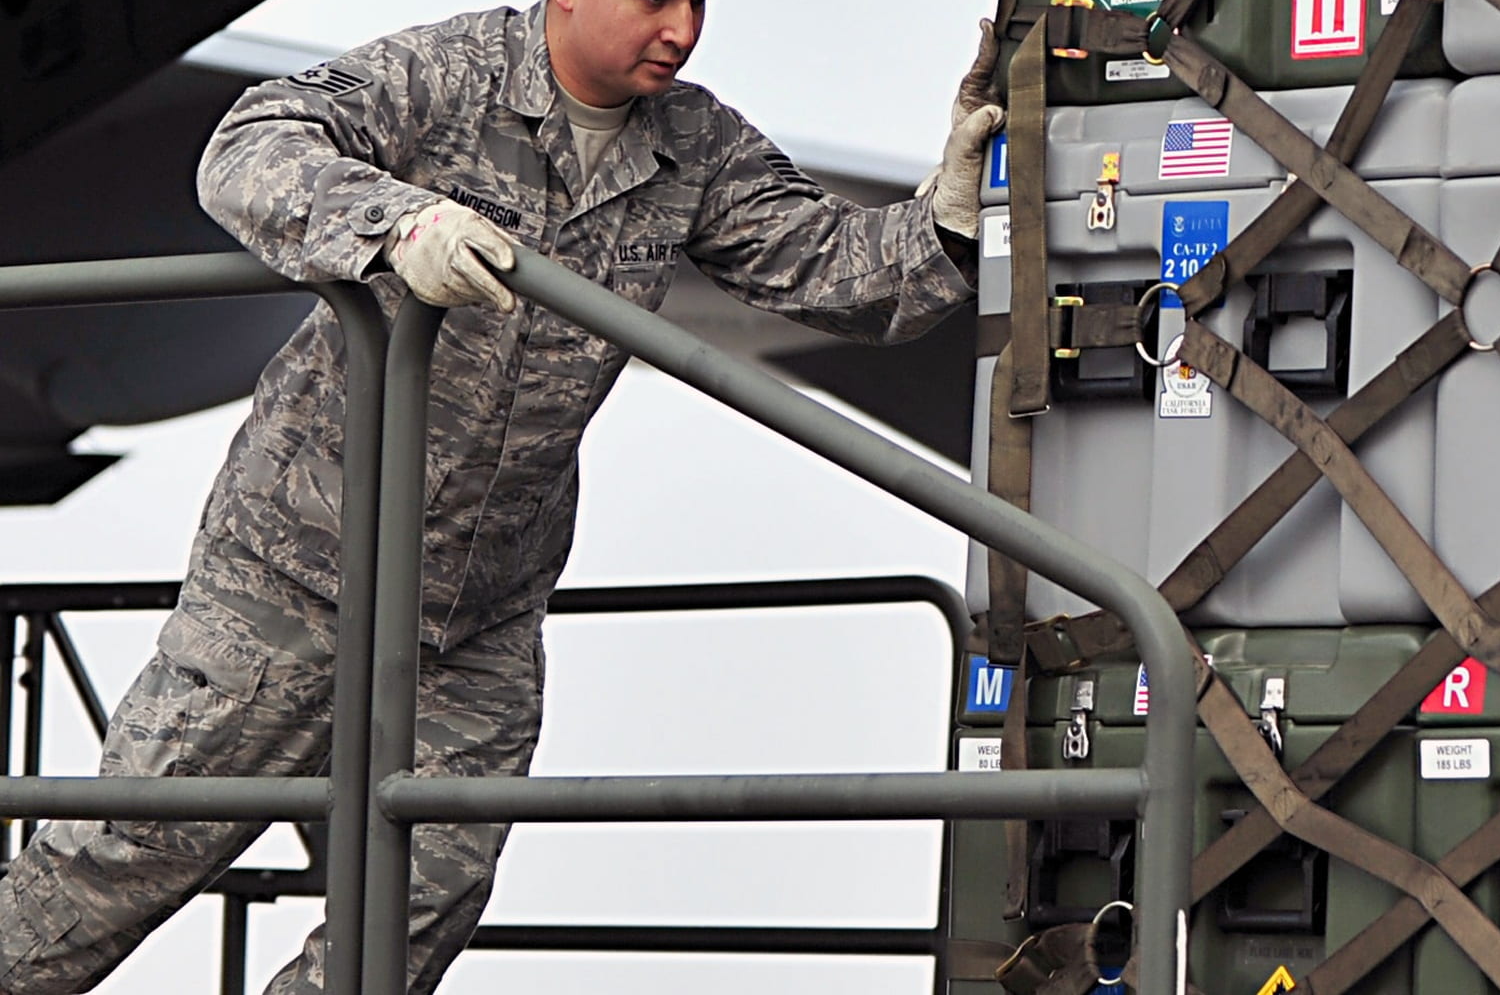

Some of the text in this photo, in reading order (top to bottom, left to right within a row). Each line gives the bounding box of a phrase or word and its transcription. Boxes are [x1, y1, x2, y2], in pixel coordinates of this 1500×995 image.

[448, 187, 522, 230] ANDERSON
[619, 245, 641, 261] U.S.
[647, 244, 666, 261] AIR
[1173, 242, 1209, 256] CA-TF
[1164, 258, 1199, 278] 2 10
[976, 668, 1003, 705] M
[1443, 666, 1470, 708] R
[978, 745, 1000, 756] WEIG
[1437, 745, 1472, 755] WEIGHT
[990, 759, 1001, 769] LB
[1453, 759, 1472, 770] LBS
